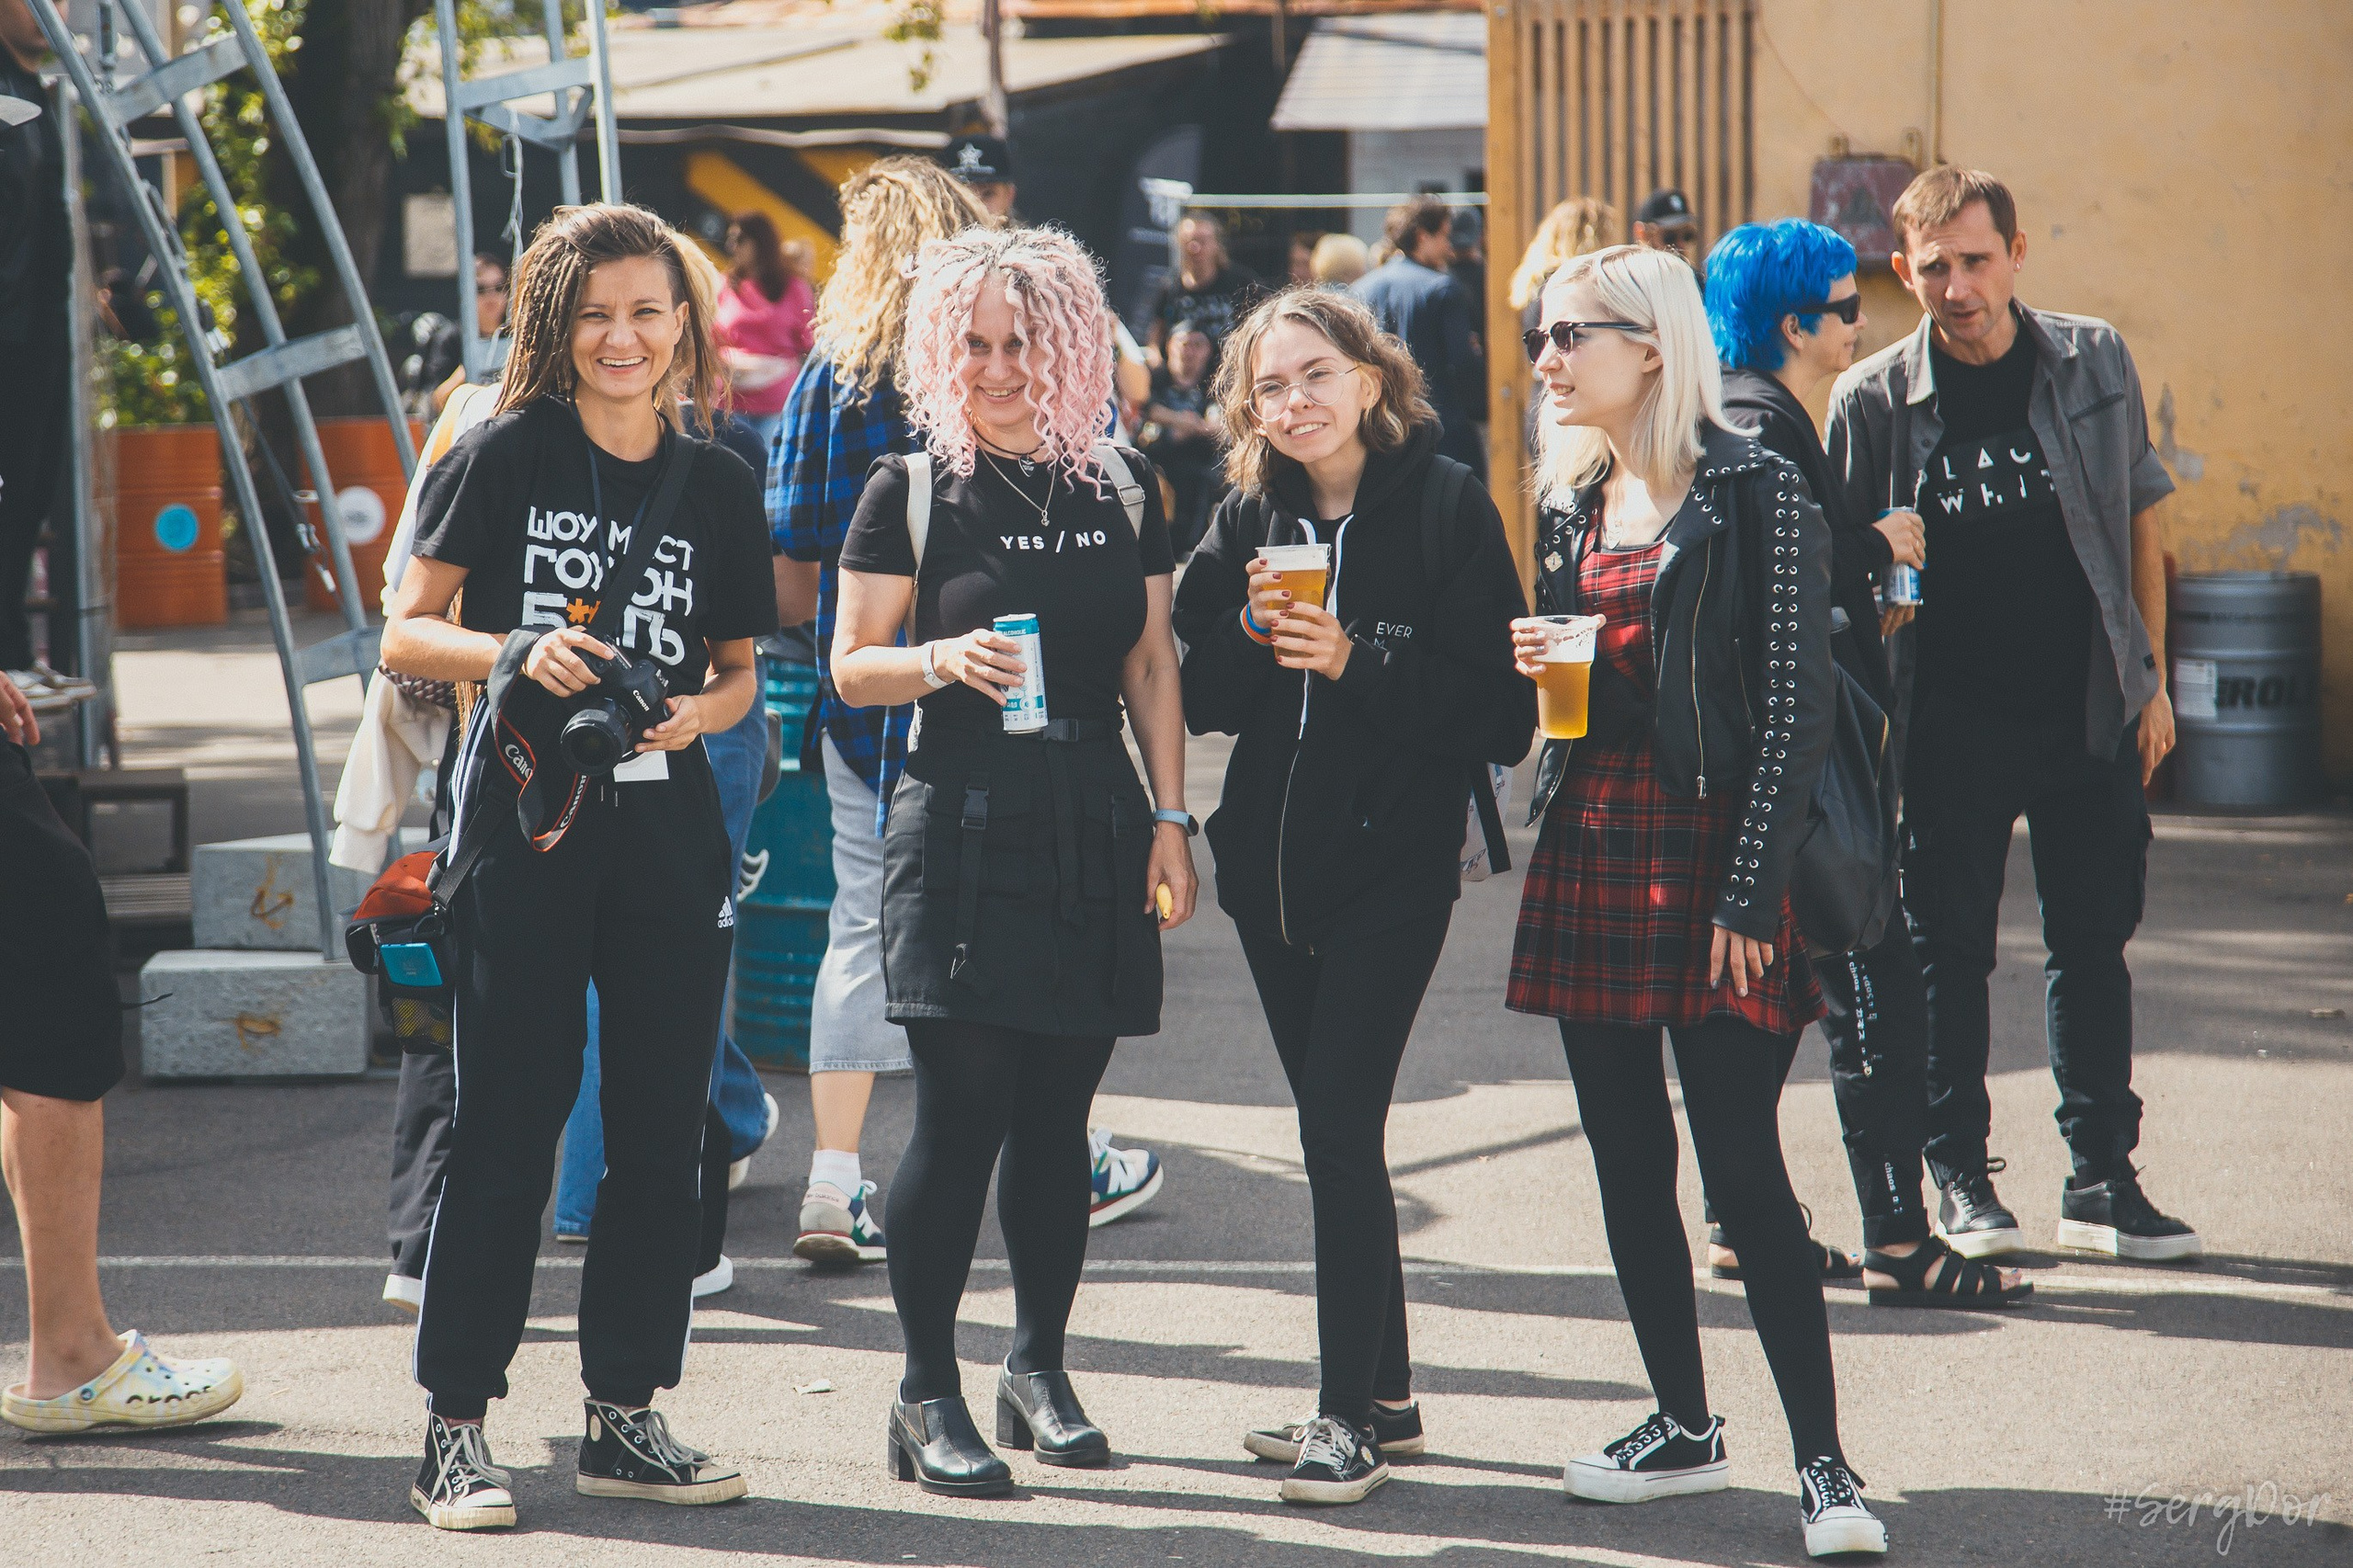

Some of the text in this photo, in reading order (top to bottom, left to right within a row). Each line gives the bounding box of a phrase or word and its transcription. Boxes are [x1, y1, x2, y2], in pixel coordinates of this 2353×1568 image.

[528, 506, 695, 571] ШОУ МСТ
[1000, 535, 1045, 550] YES
[1075, 529, 1107, 548] NO
[1376, 621, 1413, 639] EVER
[632, 689, 650, 711] Canon
[506, 744, 533, 778] Cano
[560, 775, 587, 828] Canon
[1884, 1162, 1896, 1192] chaos
